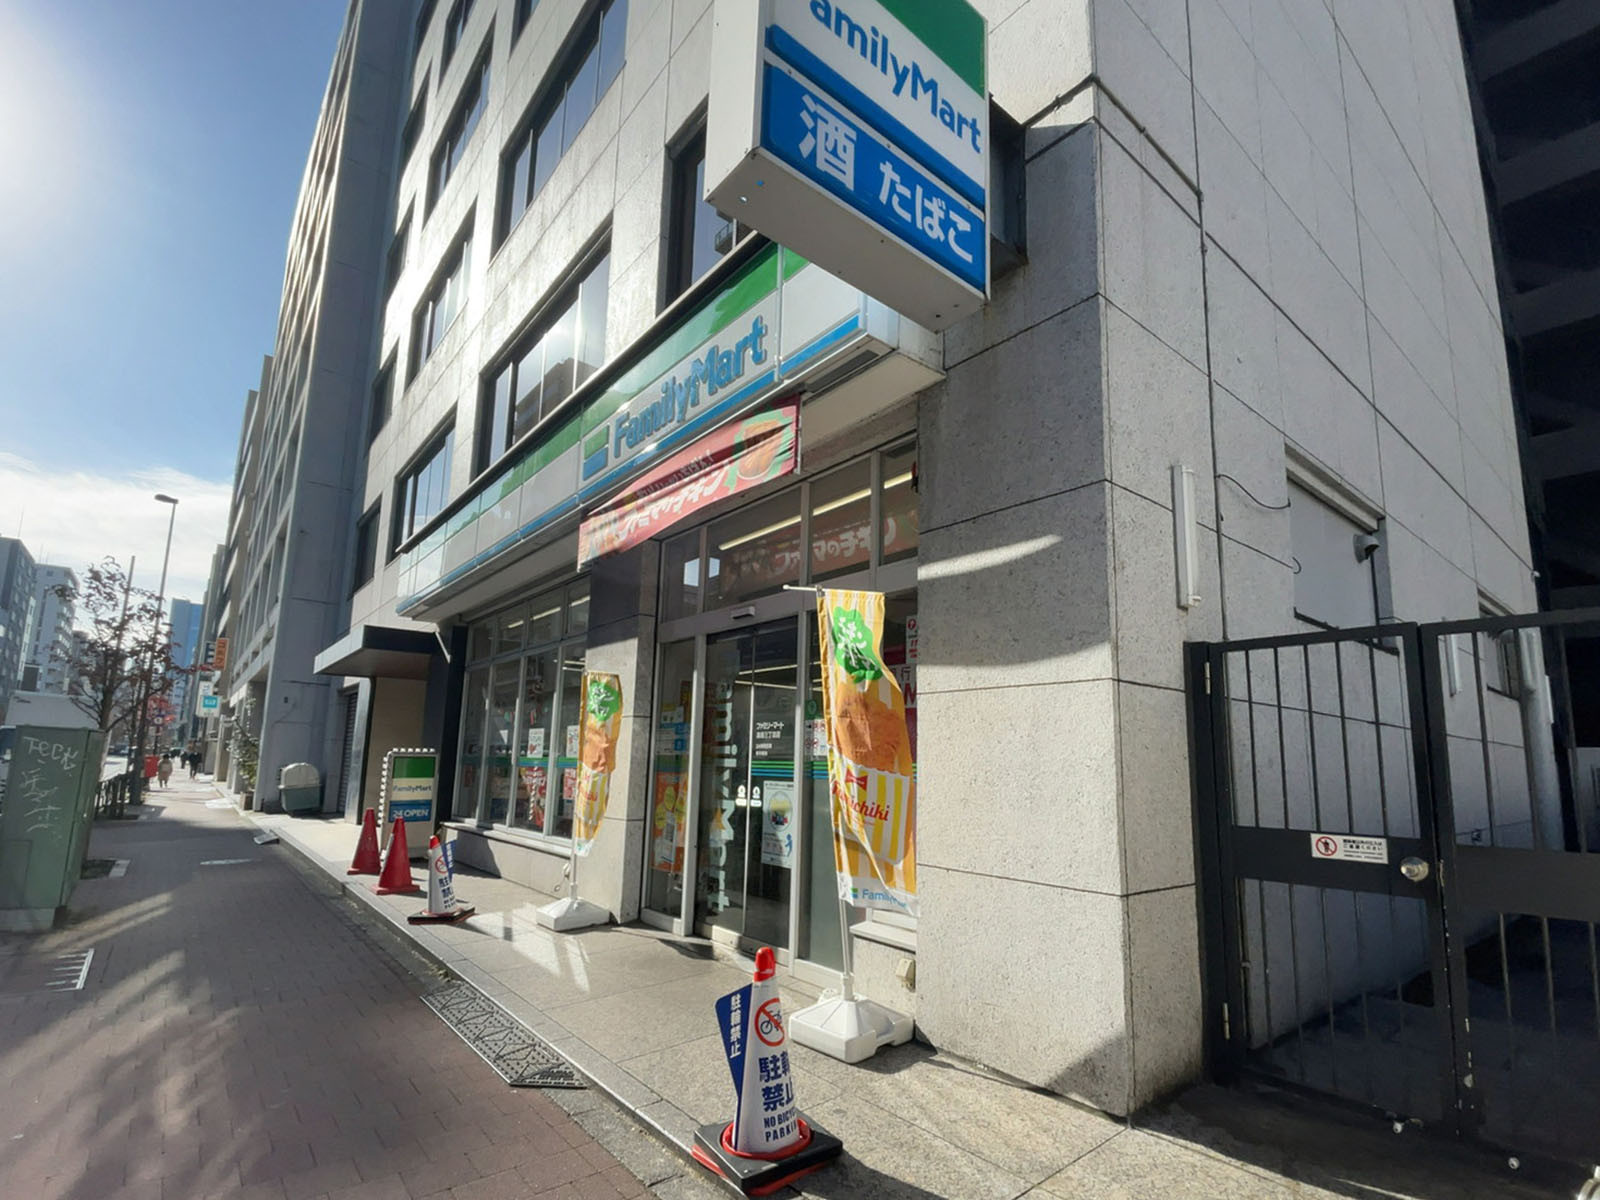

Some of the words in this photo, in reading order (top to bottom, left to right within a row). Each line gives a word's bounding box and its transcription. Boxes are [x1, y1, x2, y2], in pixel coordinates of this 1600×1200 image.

[799, 94, 857, 191] 酒
[879, 160, 974, 264] たばこ
[614, 315, 768, 458] FamilyMart
[404, 809, 429, 817] OPEN
[764, 1116, 776, 1128] NO
